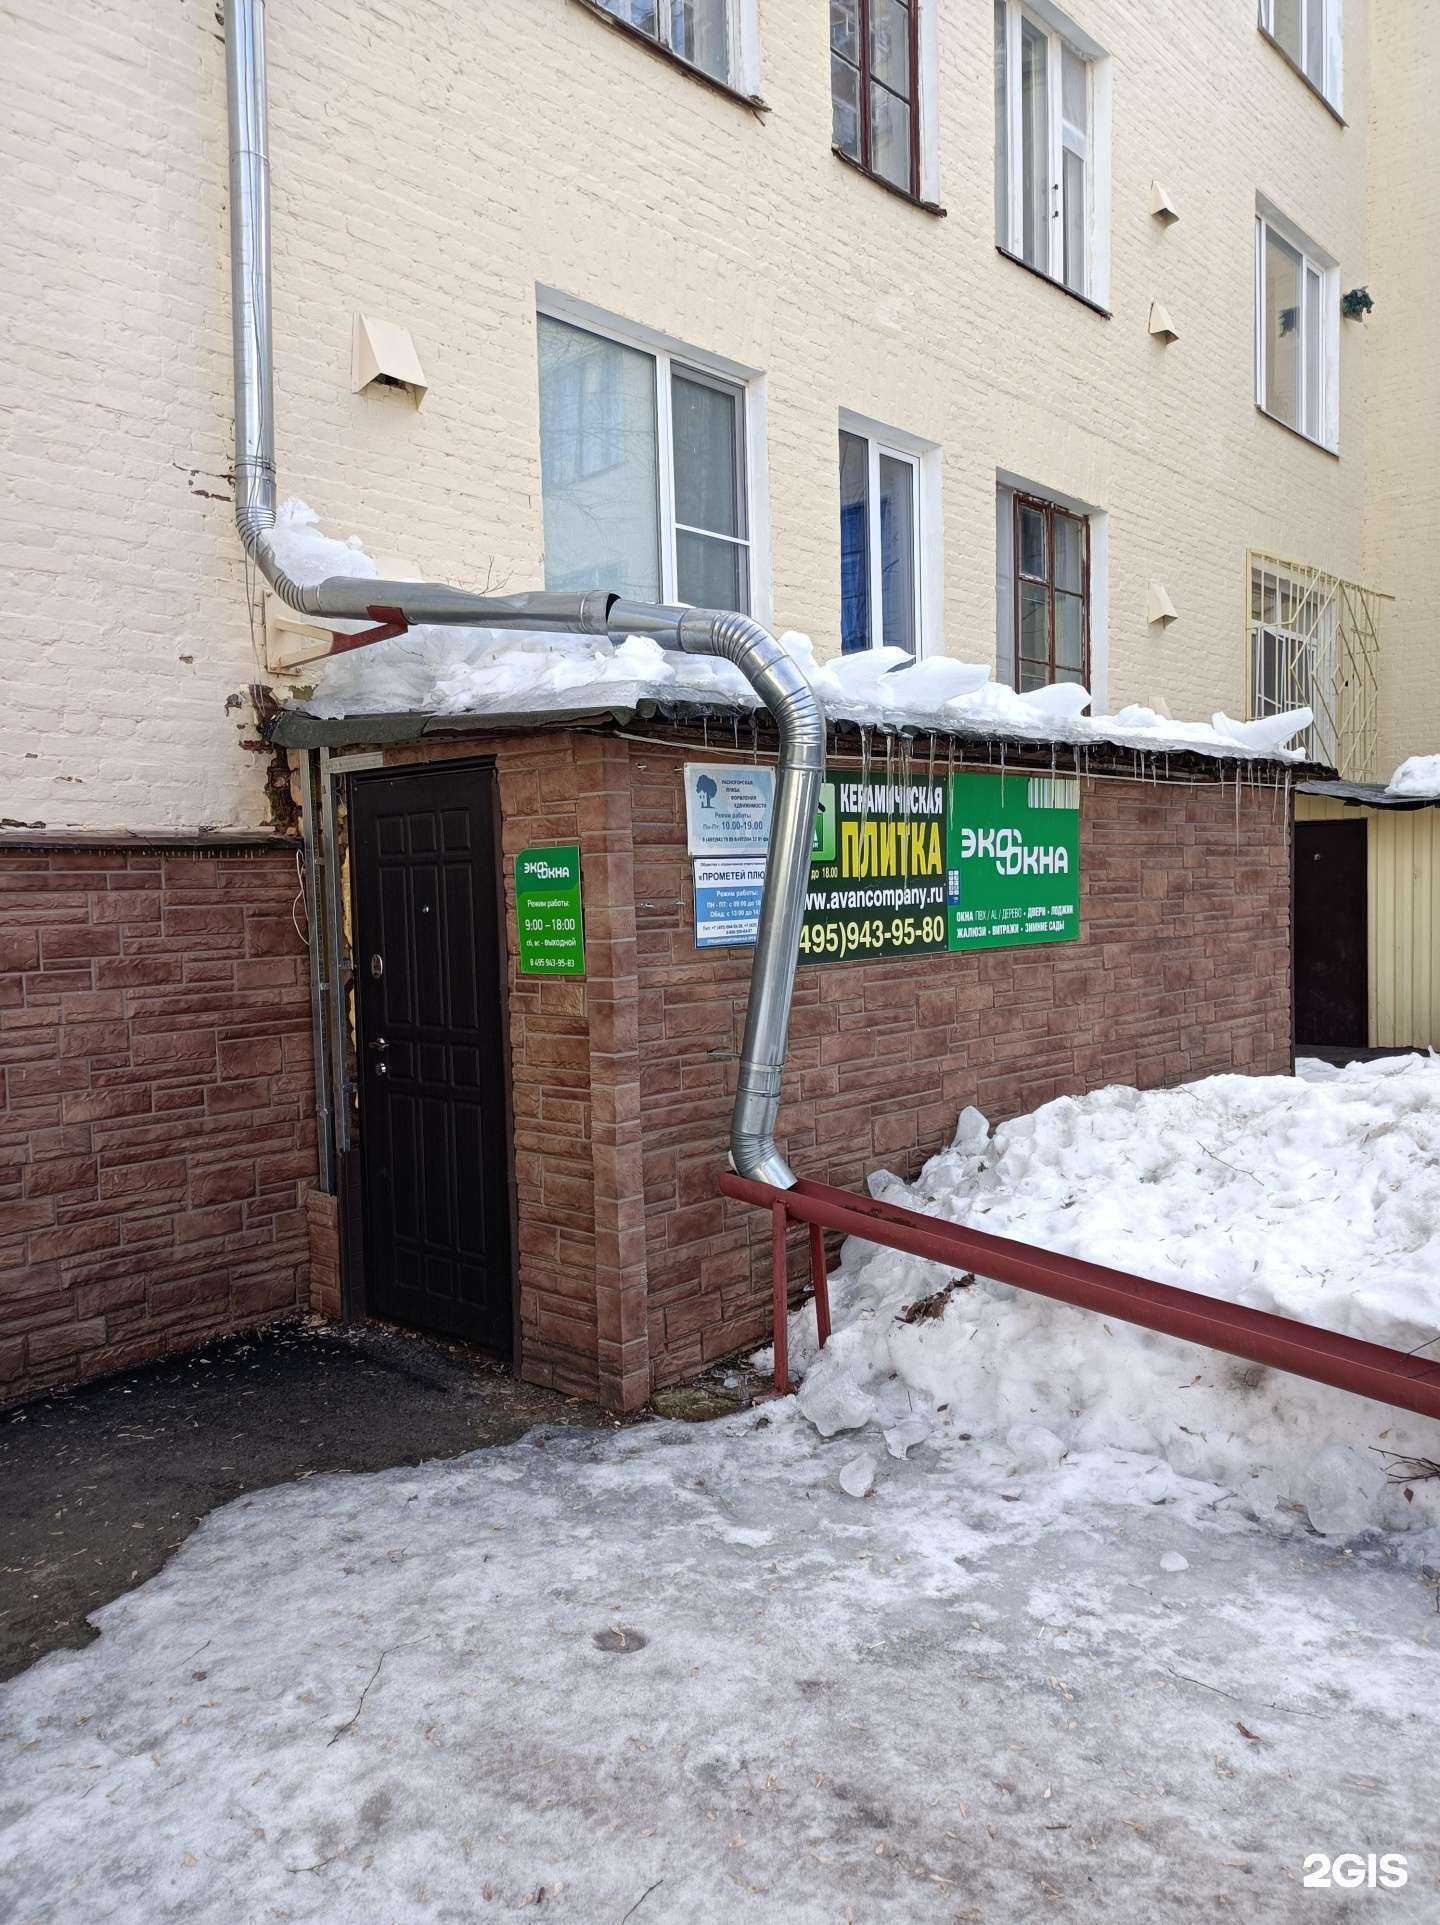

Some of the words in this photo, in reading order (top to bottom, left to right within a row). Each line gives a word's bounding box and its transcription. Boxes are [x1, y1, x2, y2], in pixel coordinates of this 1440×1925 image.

[722, 821, 763, 830] 10.00-19.00
[841, 821, 943, 879] ПЛИТКА
[699, 869, 746, 881] «ПРОМЕТЕЙ
[811, 870, 819, 880] до
[822, 867, 838, 878] 18.00
[716, 890, 735, 898] Режим
[527, 899, 547, 908] Режим
[956, 911, 973, 922] ОКНА
[974, 910, 988, 921] ПВХ
[1001, 907, 1022, 920] ДЕРЕВО
[1028, 906, 1046, 918] ДВЕРИ
[525, 918, 543, 931] 9:00
[552, 918, 575, 931] 18:00
[957, 926, 987, 938] ЖАЛЮЗИ
[992, 923, 1019, 936] ВИТРАЖИ
[1025, 921, 1047, 933] ЗИМНИЕ
[1048, 920, 1065, 932] САДЫ
[799, 916, 945, 958] 495)943-95-80
